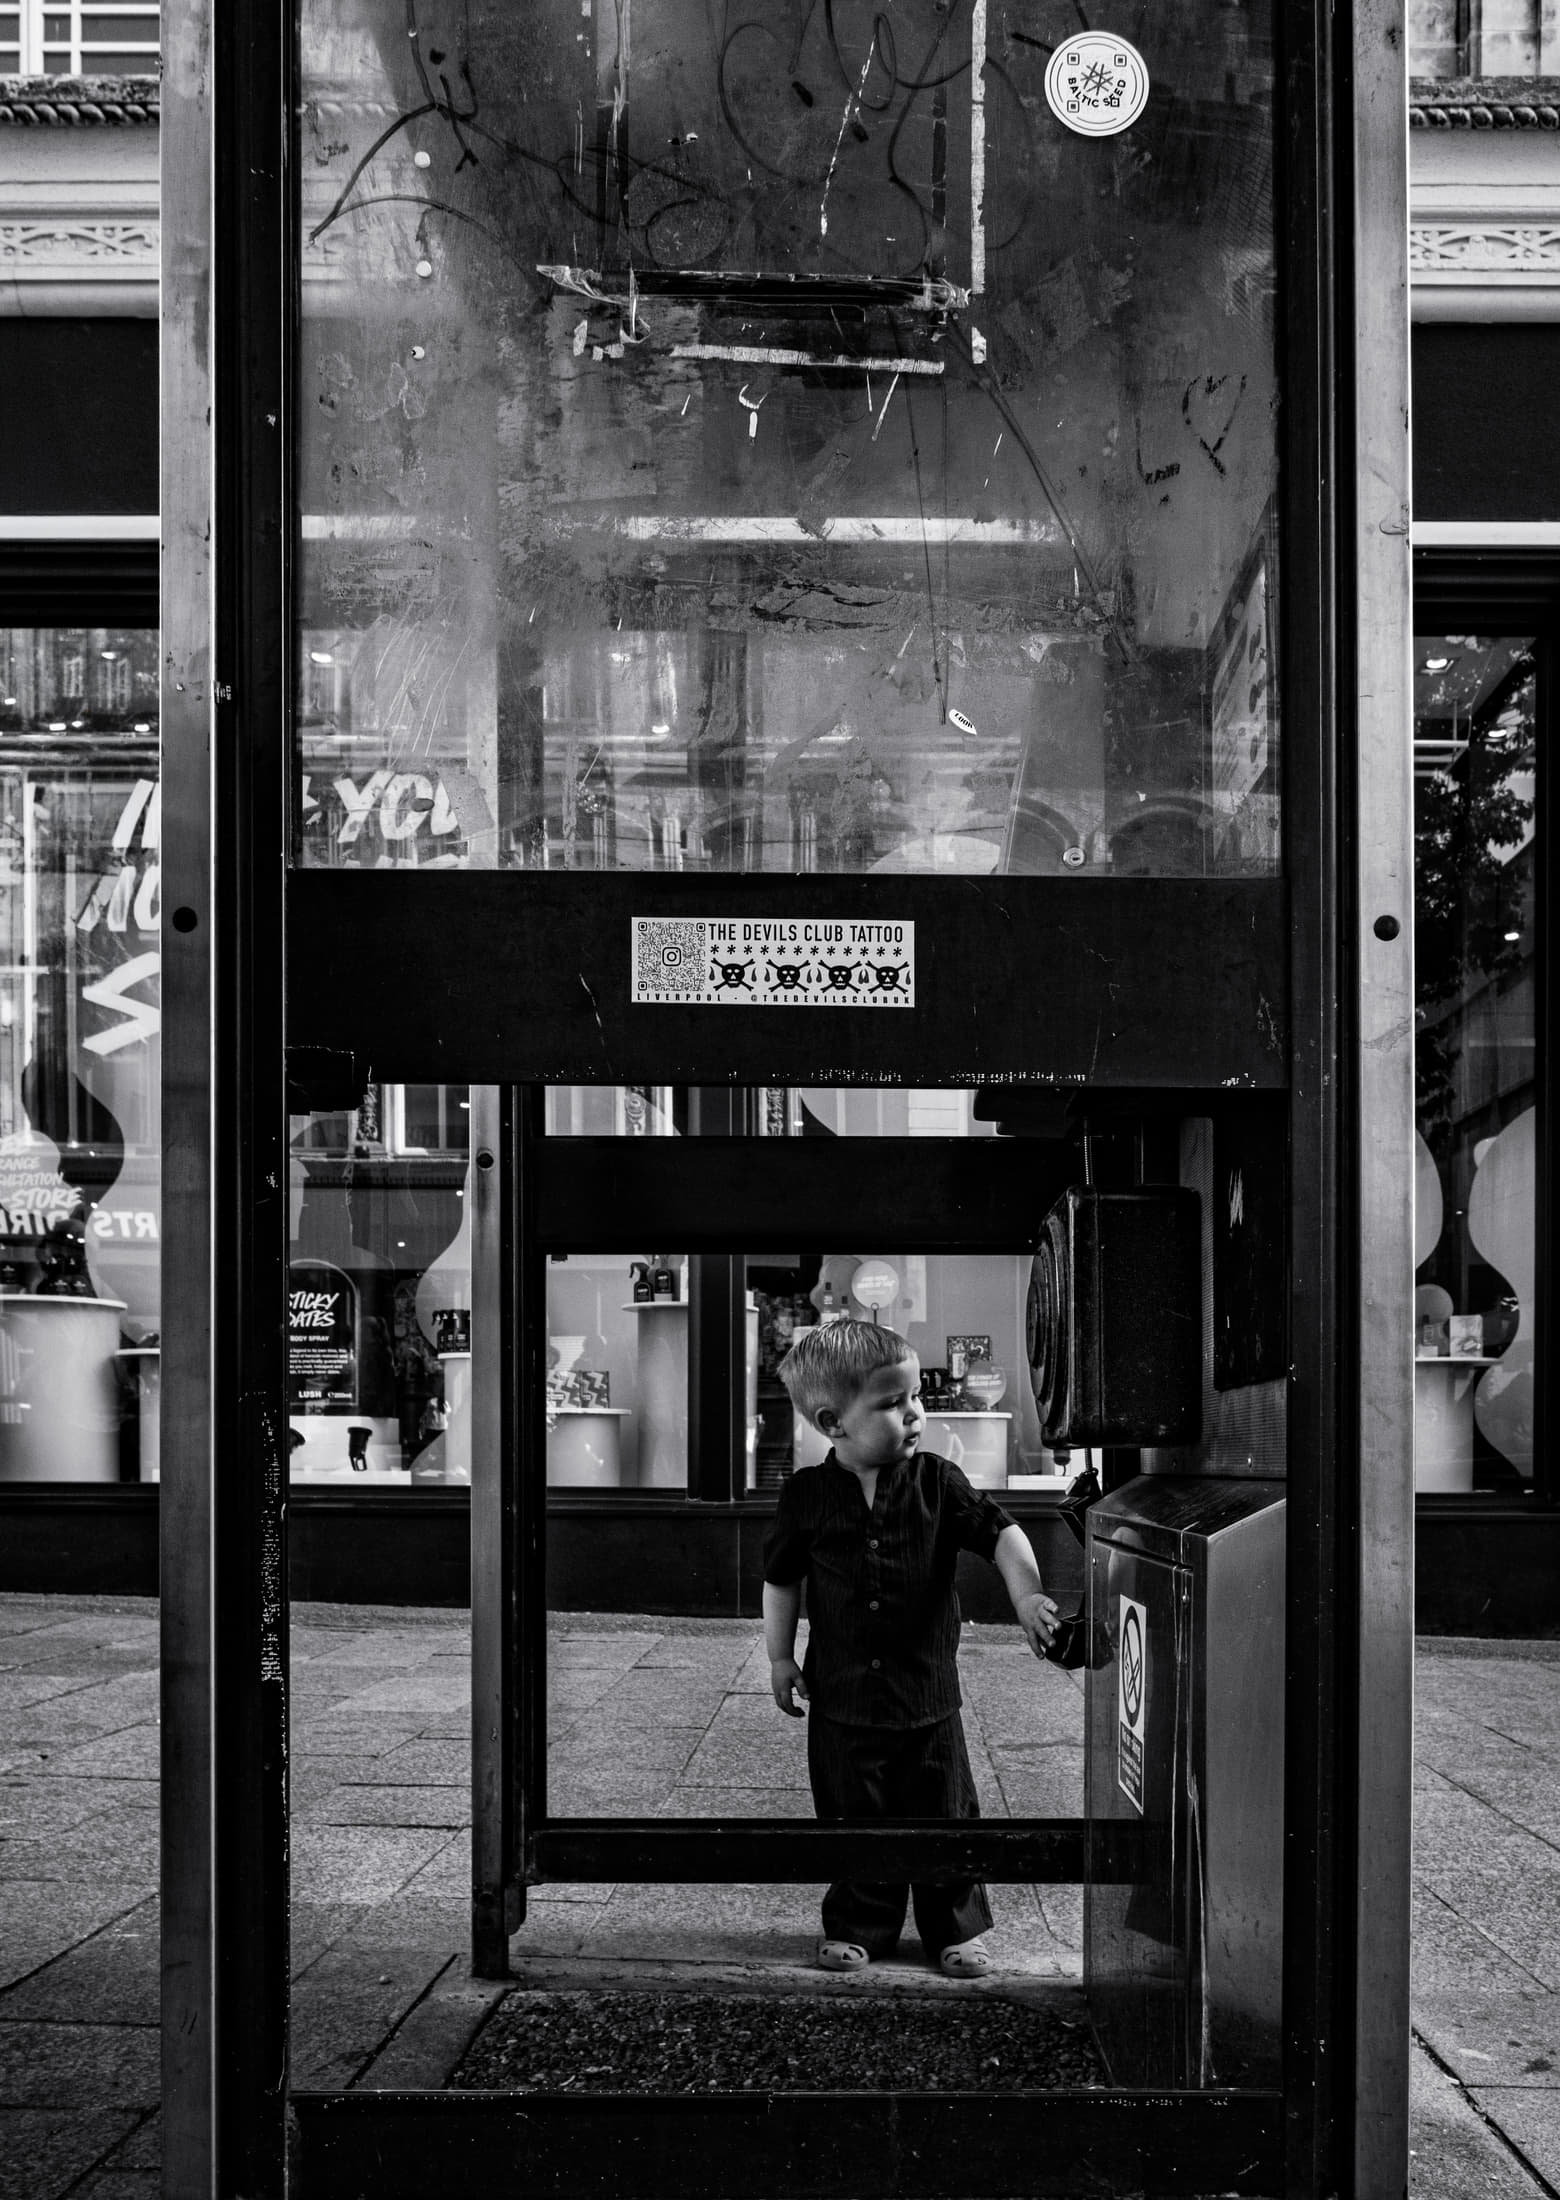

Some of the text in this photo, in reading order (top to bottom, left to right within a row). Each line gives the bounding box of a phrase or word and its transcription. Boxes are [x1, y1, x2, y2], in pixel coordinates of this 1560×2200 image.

[1068, 77, 1099, 108] BALTIC
[708, 923, 904, 943] THE DEVILS CLUB TATTOO
[637, 993, 721, 1002] LIVERPOOL
[298, 1390, 322, 1398] LUSH
